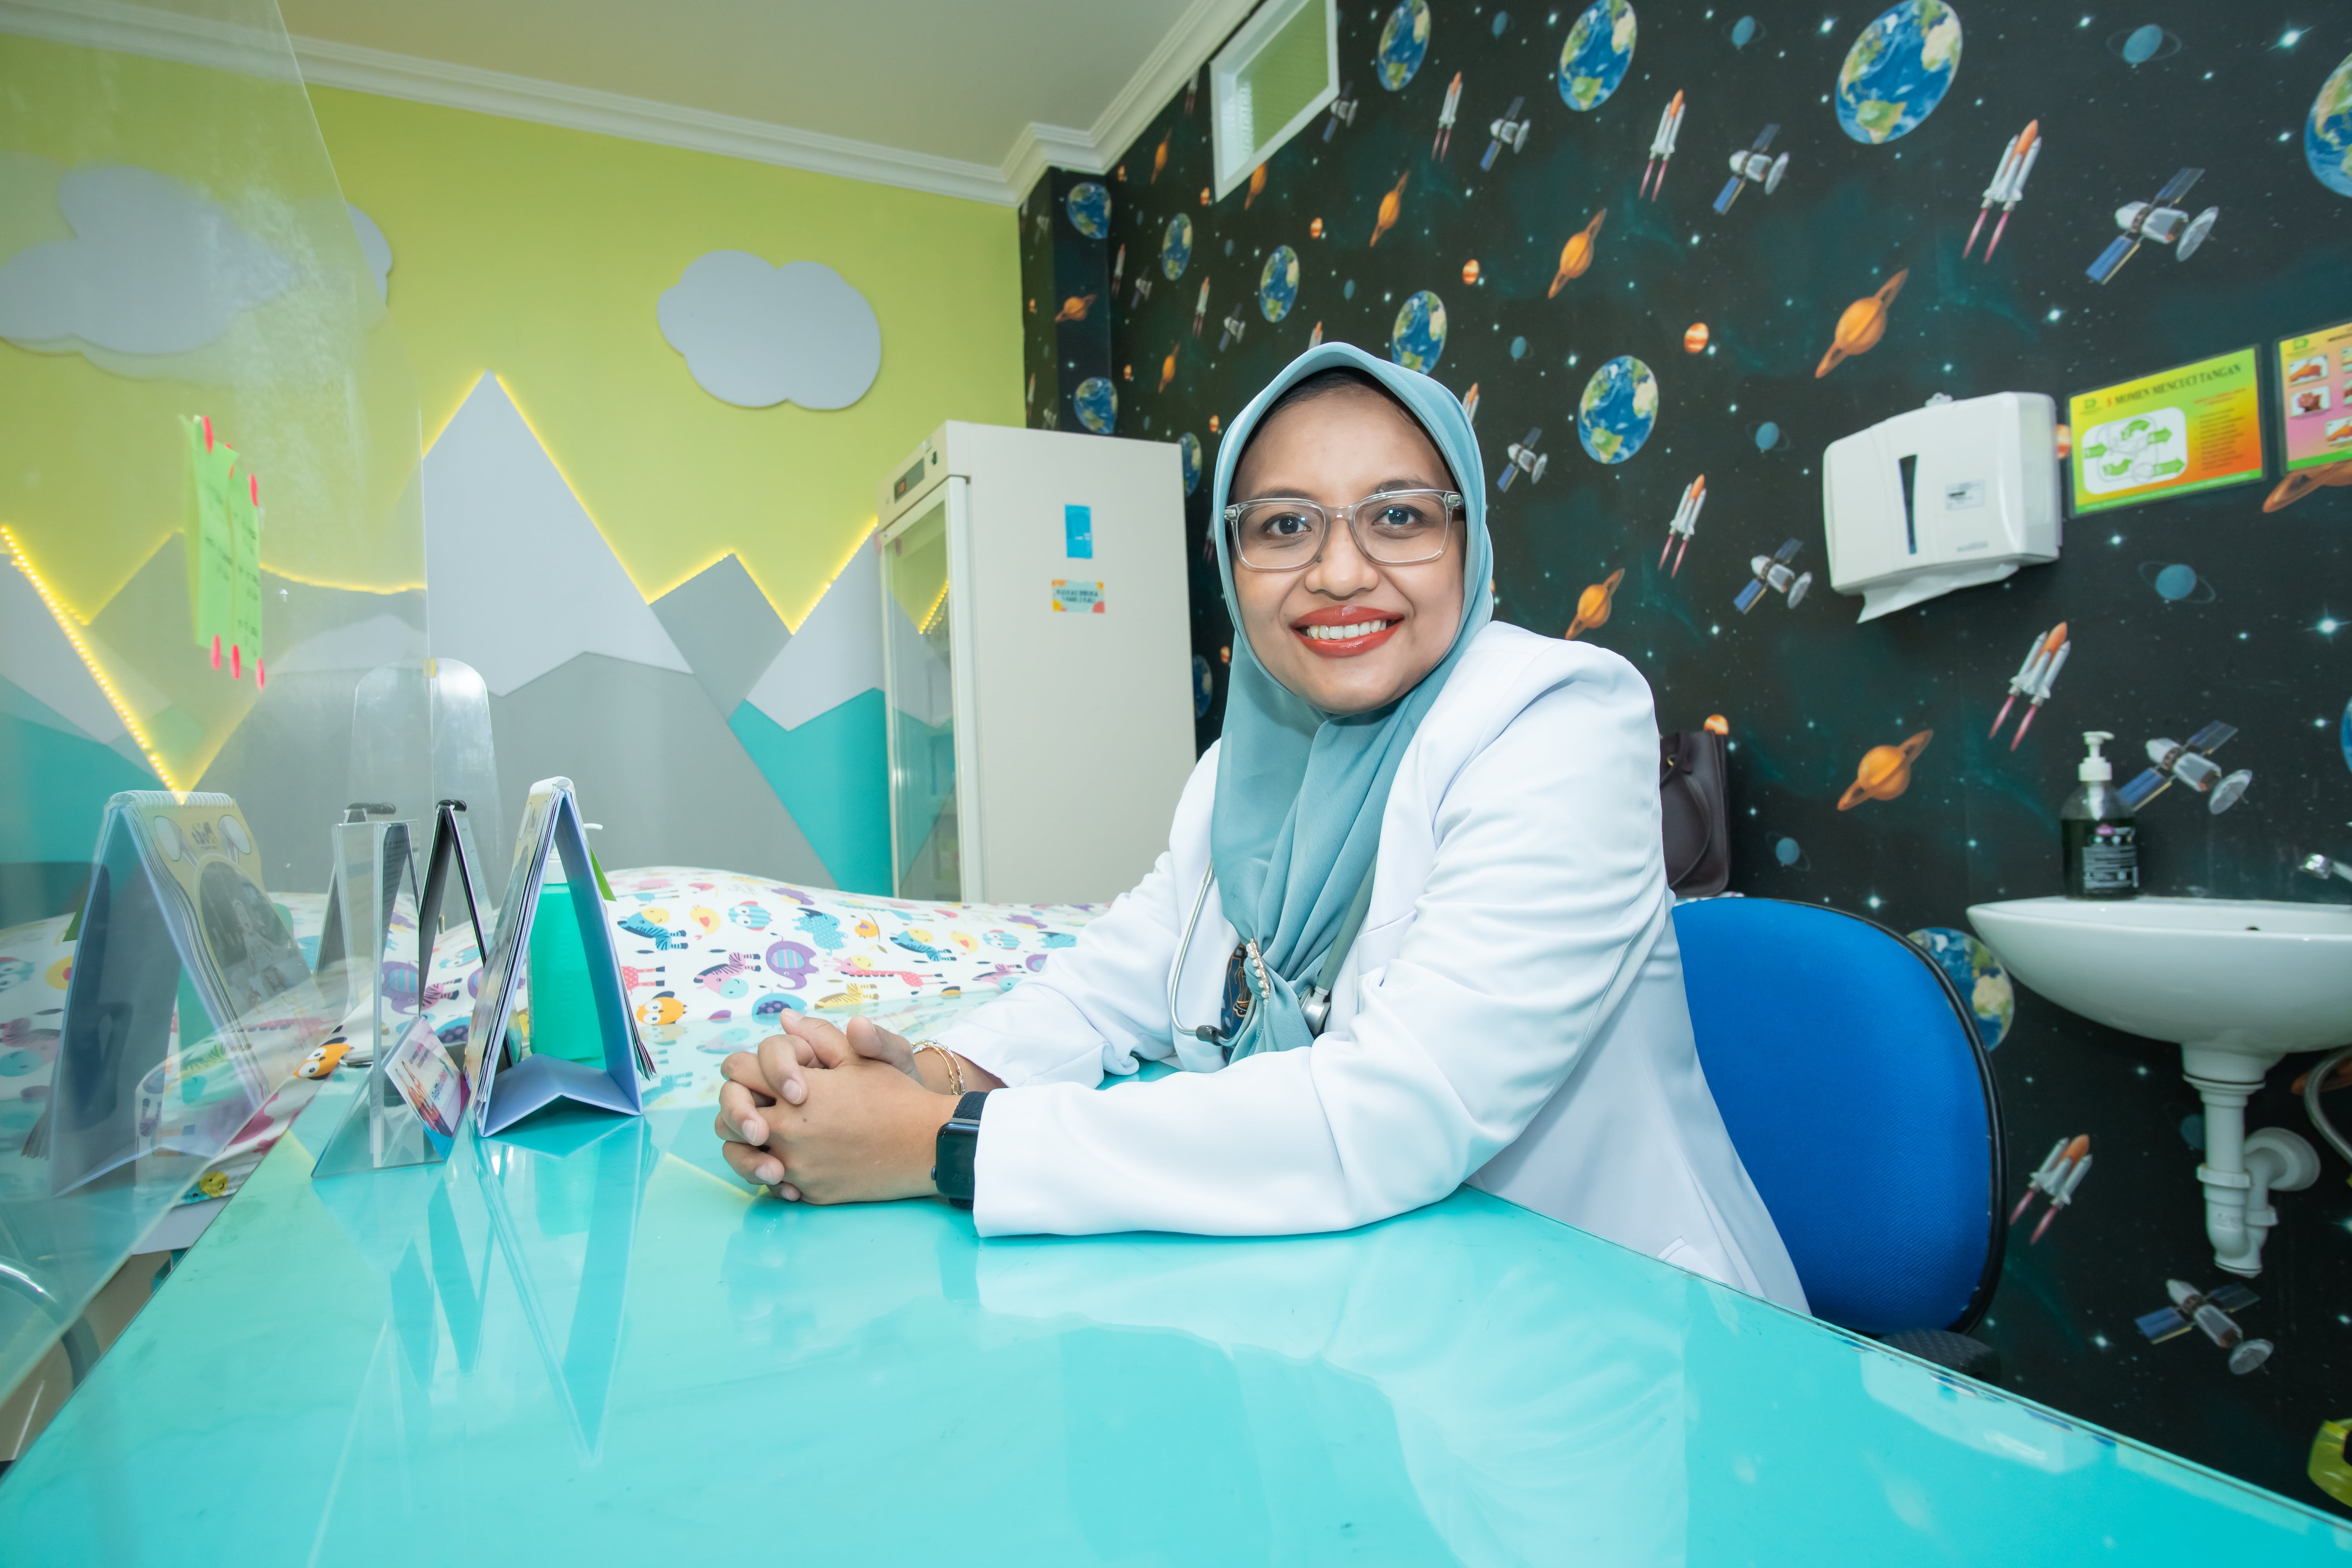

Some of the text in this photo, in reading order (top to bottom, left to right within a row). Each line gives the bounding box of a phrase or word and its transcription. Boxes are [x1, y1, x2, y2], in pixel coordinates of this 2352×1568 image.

[2115, 388, 2150, 404] MOMEN
[2152, 375, 2197, 395] MENCUCI
[2200, 364, 2241, 383] TANGAN
